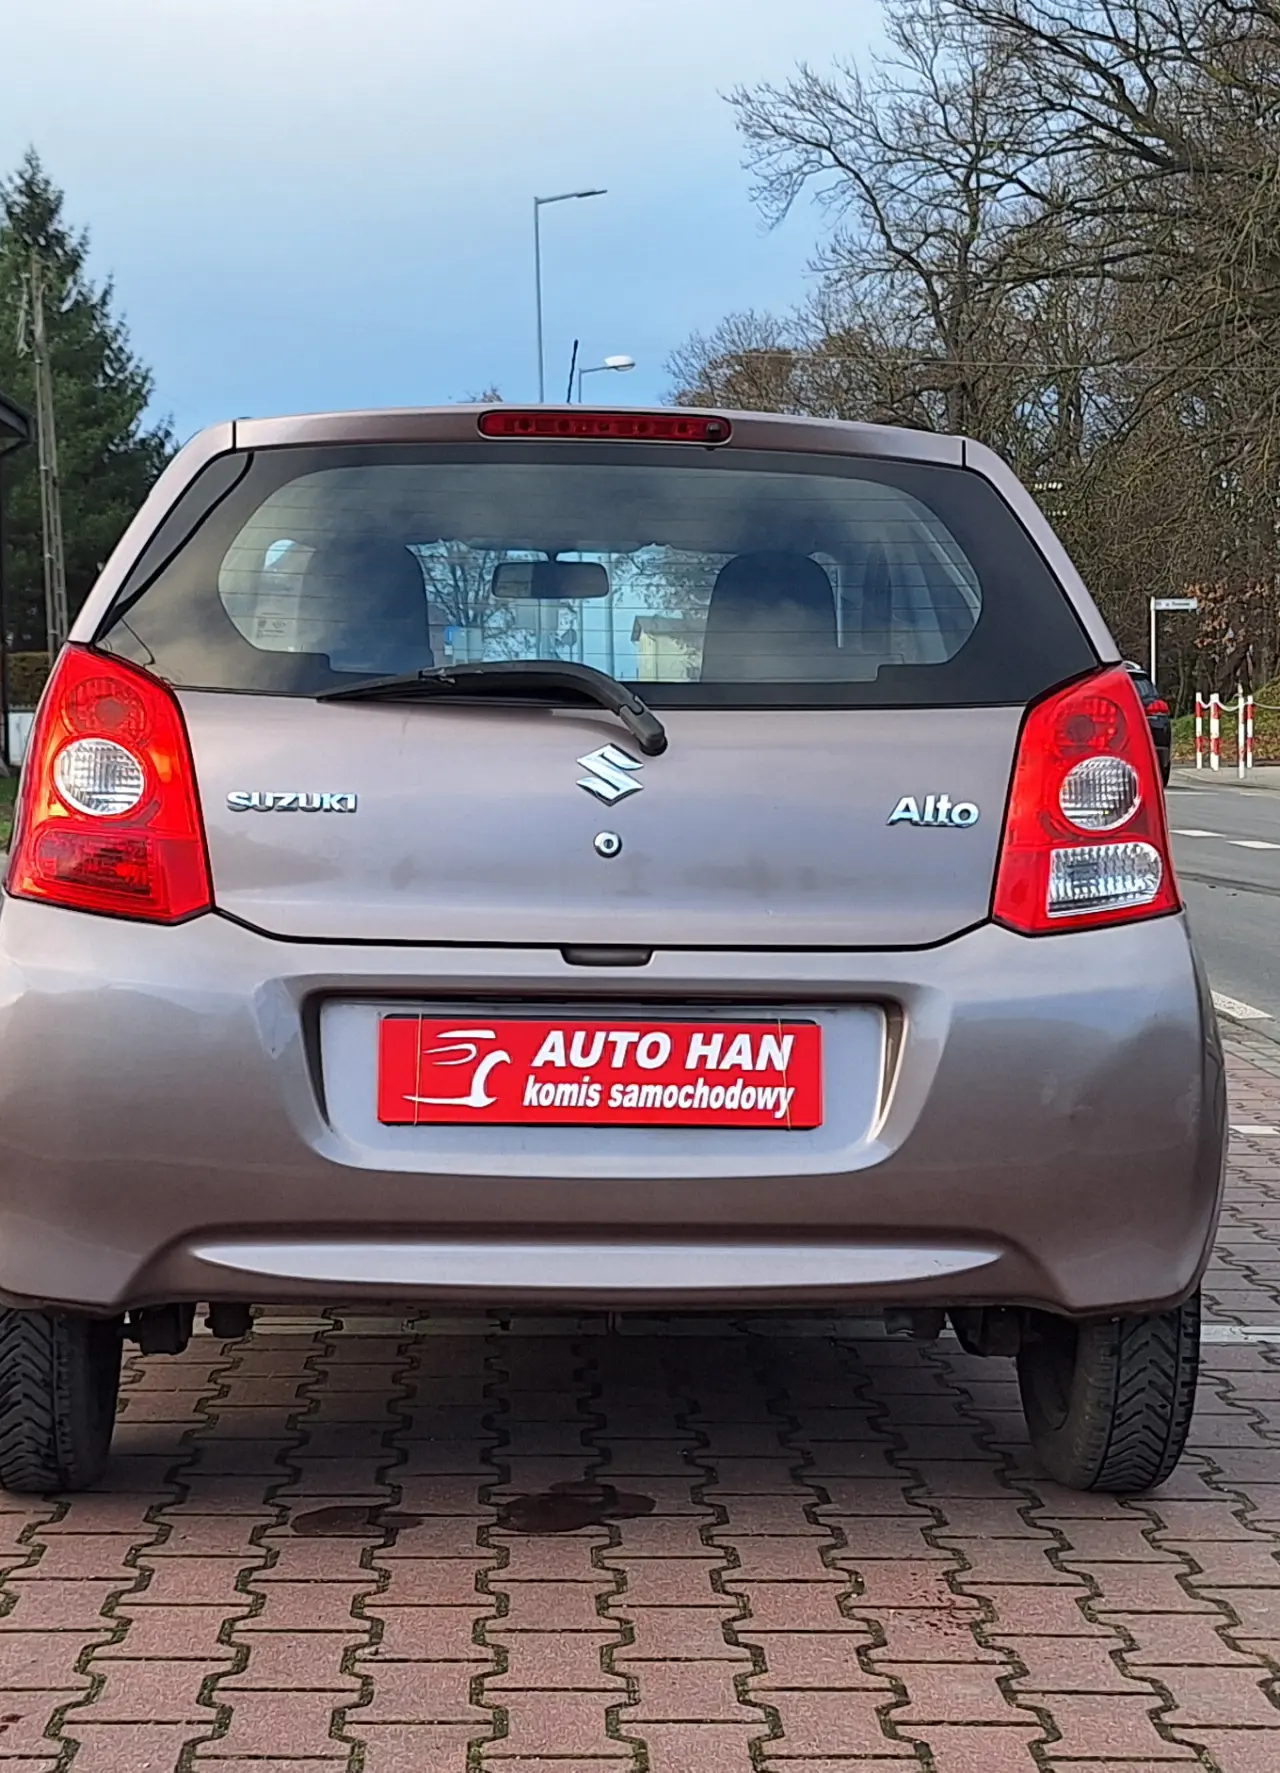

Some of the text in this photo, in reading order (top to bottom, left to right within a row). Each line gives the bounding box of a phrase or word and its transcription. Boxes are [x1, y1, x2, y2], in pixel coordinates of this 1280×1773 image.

[226, 790, 357, 813] SUZUKI
[885, 793, 980, 829] Alto
[530, 1030, 796, 1072] AUTO HAN
[522, 1075, 795, 1119] komis samochodowy
